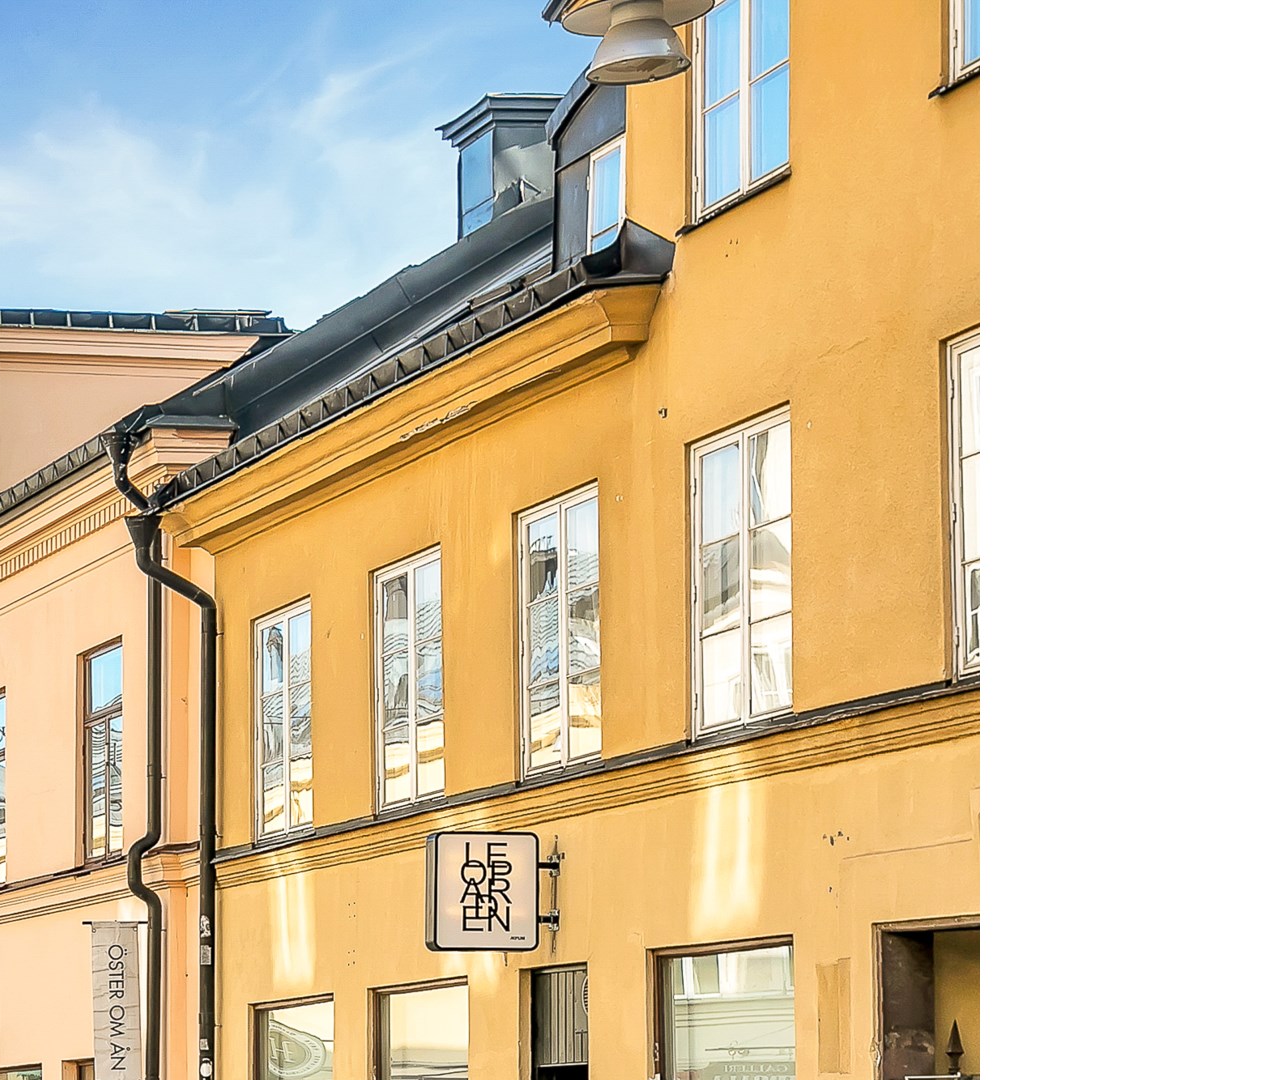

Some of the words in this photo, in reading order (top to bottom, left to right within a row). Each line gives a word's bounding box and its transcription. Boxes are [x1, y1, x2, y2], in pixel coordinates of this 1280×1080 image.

[108, 944, 127, 999] ÖSTER
[109, 1005, 125, 1037] OM
[110, 1043, 130, 1071] ÅN
